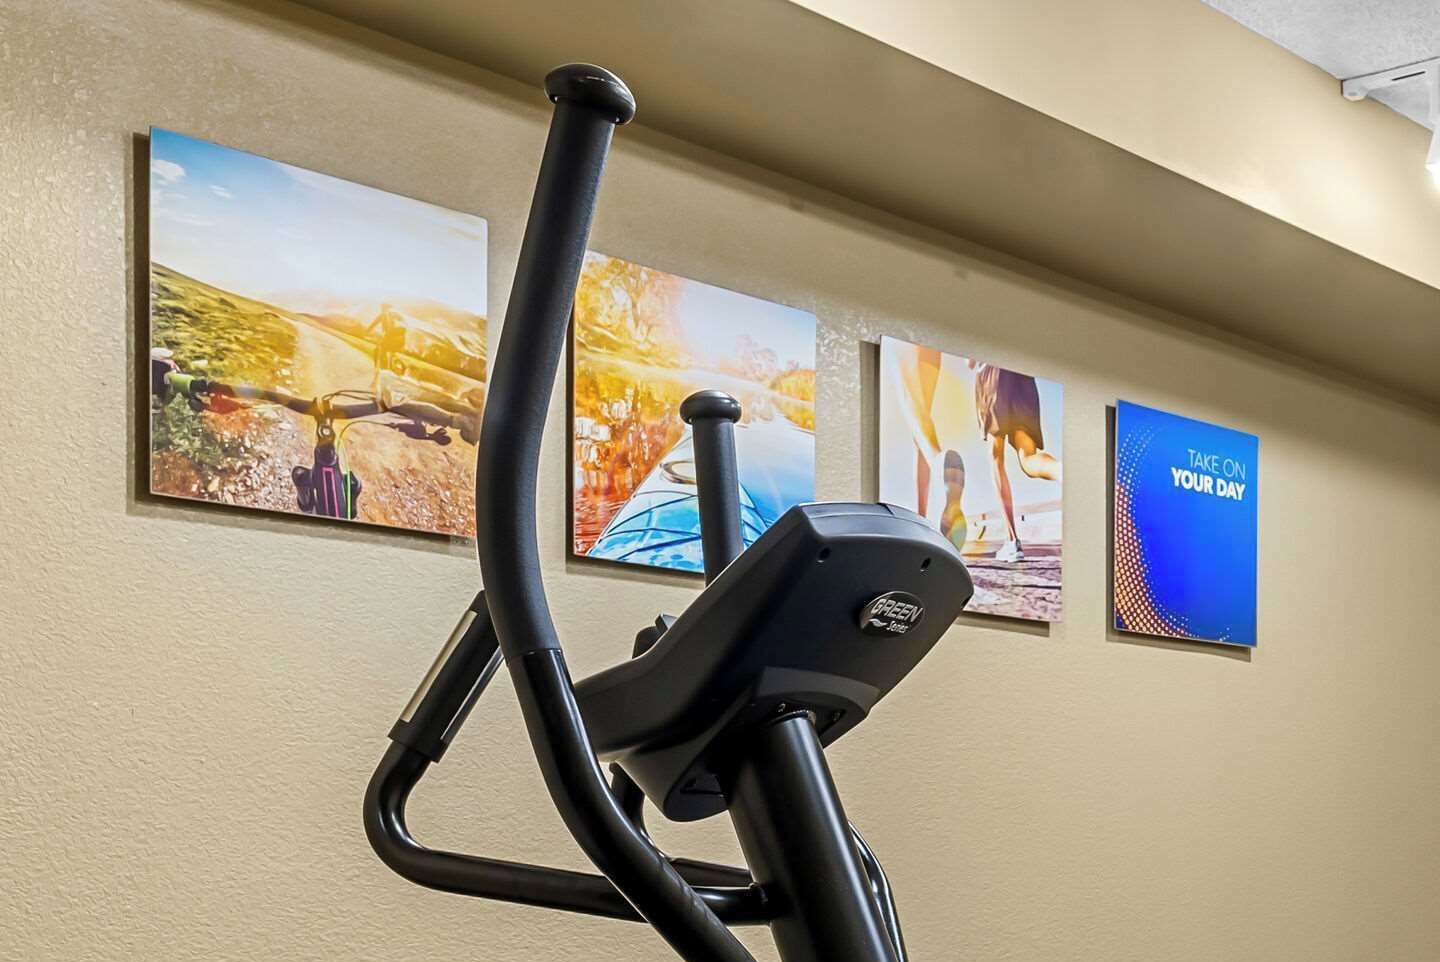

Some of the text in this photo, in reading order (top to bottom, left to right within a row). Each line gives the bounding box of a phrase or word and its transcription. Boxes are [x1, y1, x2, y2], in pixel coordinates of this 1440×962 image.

[1187, 448, 1246, 480] TAKE ON
[1170, 466, 1246, 501] YOUR DAY
[870, 598, 924, 622] GREEN
